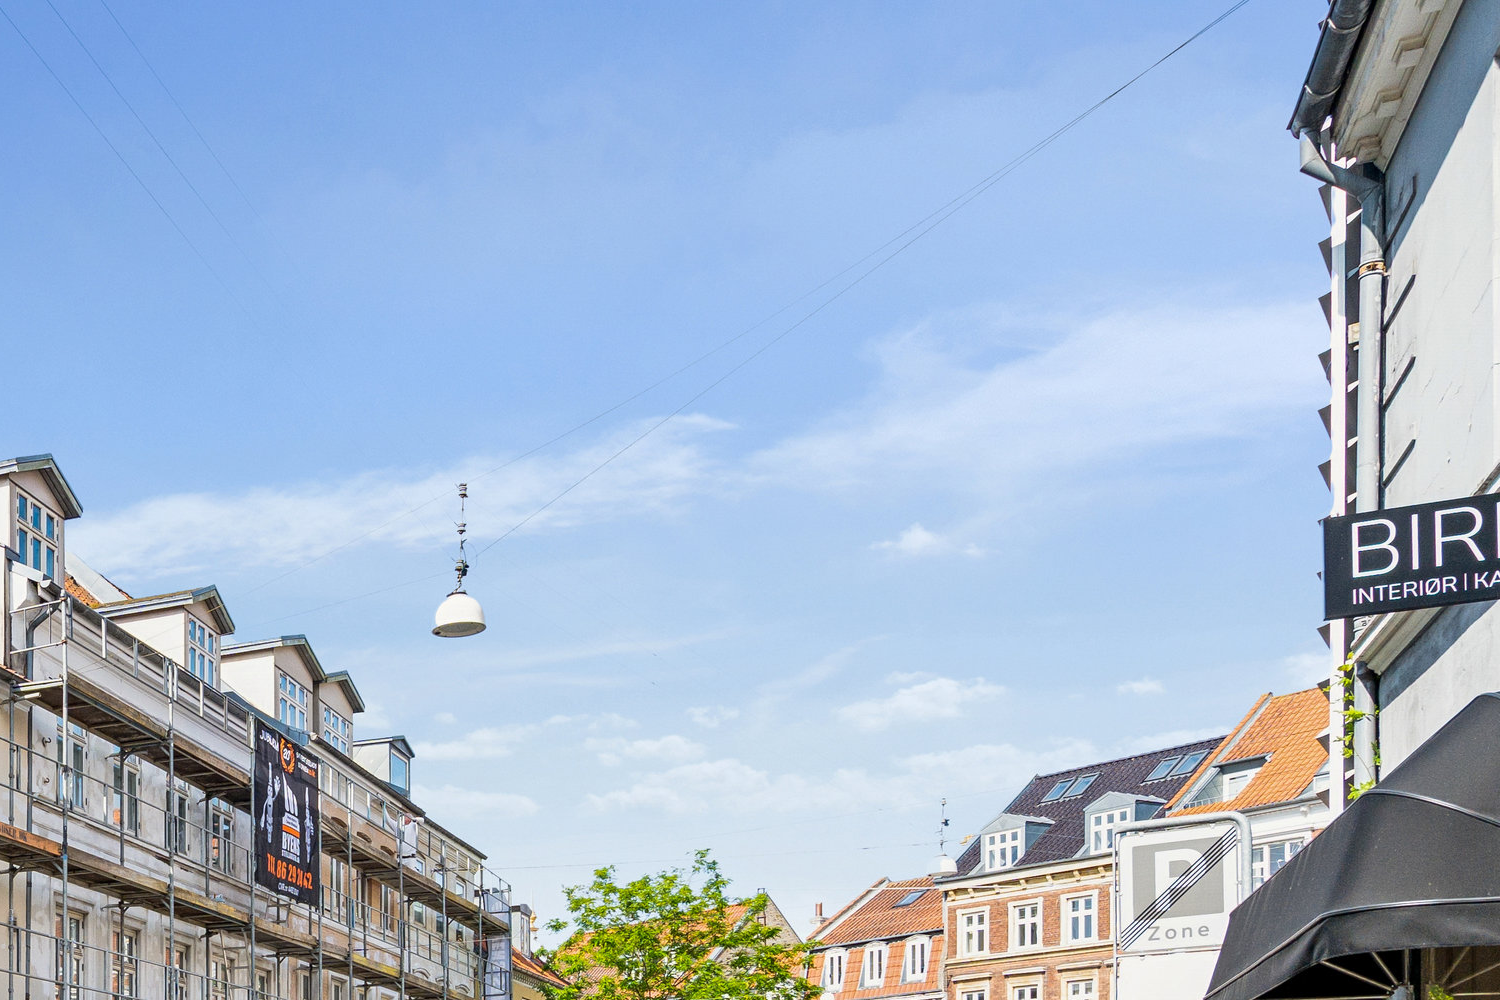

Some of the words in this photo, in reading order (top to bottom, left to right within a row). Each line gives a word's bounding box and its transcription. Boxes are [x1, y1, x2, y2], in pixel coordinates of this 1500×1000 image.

[1351, 502, 1500, 578] BIR
[1353, 576, 1457, 604] INTERIØR
[277, 859, 287, 880] 86
[288, 863, 297, 883] 29
[1147, 925, 1210, 941] Zone
